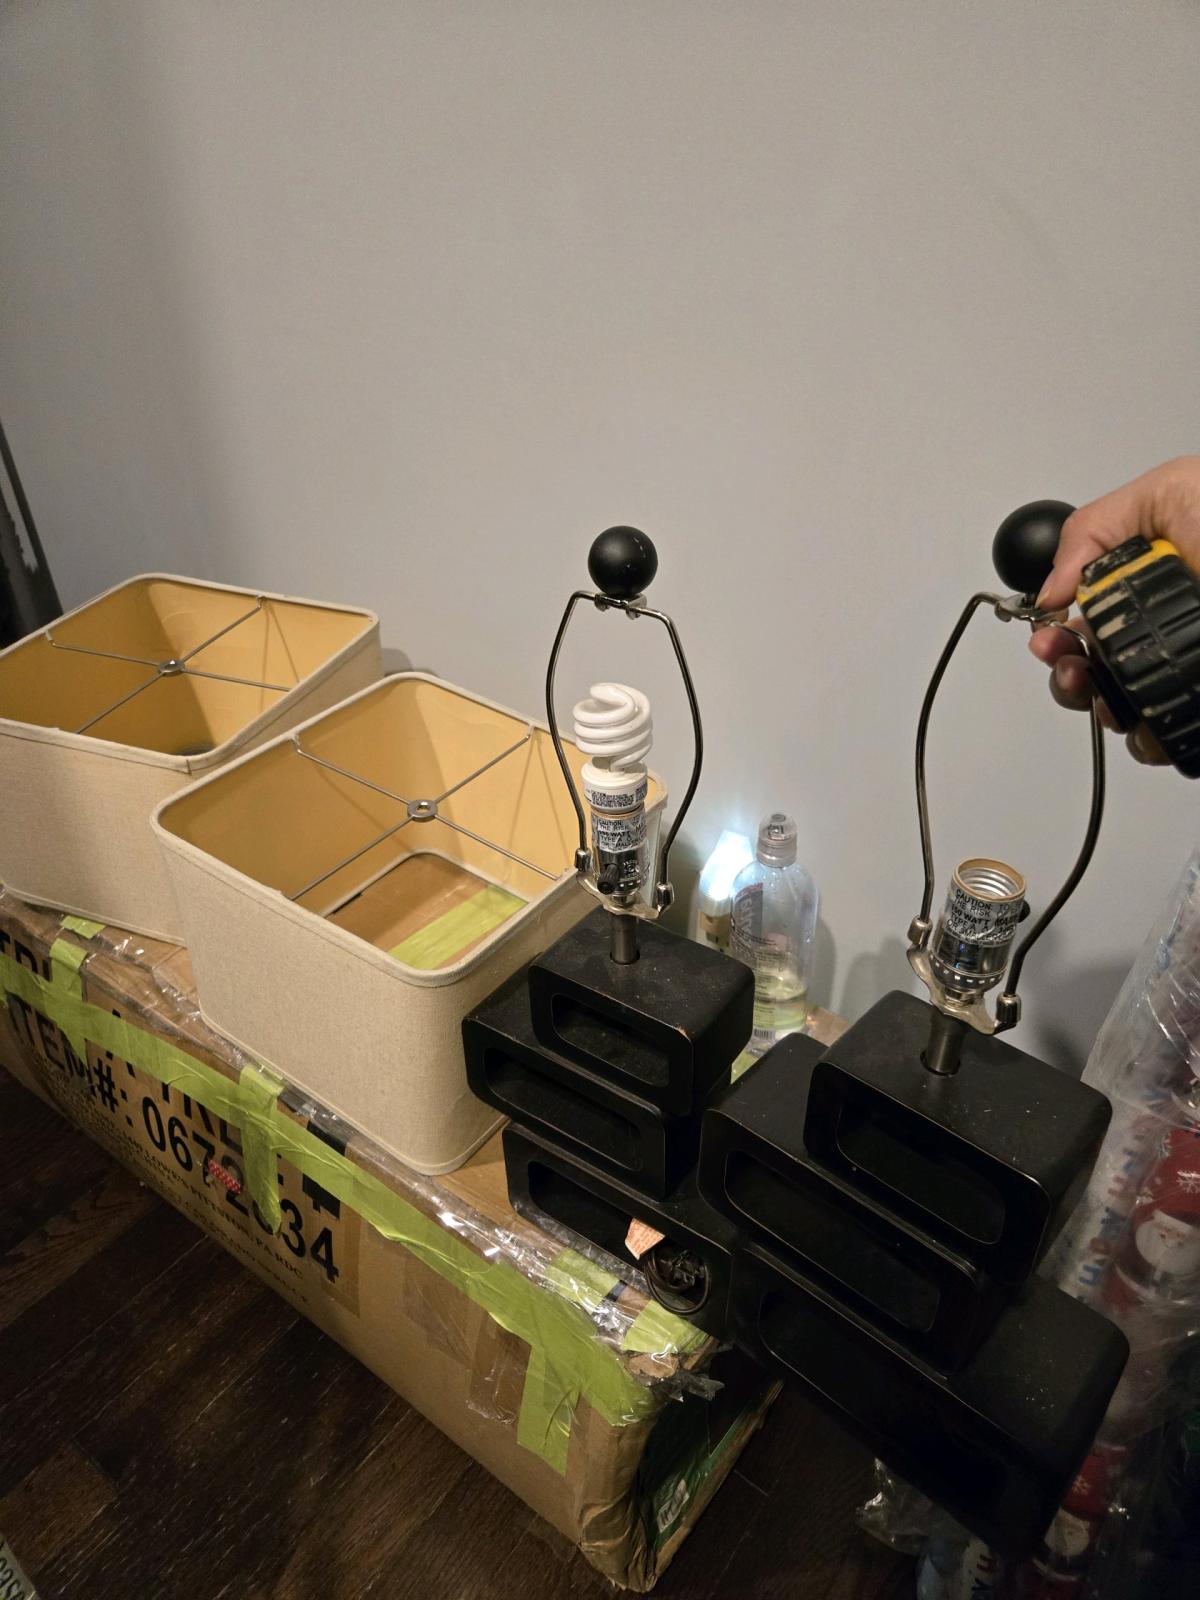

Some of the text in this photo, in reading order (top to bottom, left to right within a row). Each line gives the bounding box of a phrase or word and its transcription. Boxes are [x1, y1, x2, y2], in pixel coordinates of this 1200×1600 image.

[955, 898, 990, 917] THE RISK
[948, 920, 958, 930] OR
[952, 912, 968, 926] TYPE
[964, 913, 990, 926] WATT
[141, 1096, 340, 1284] 067234
